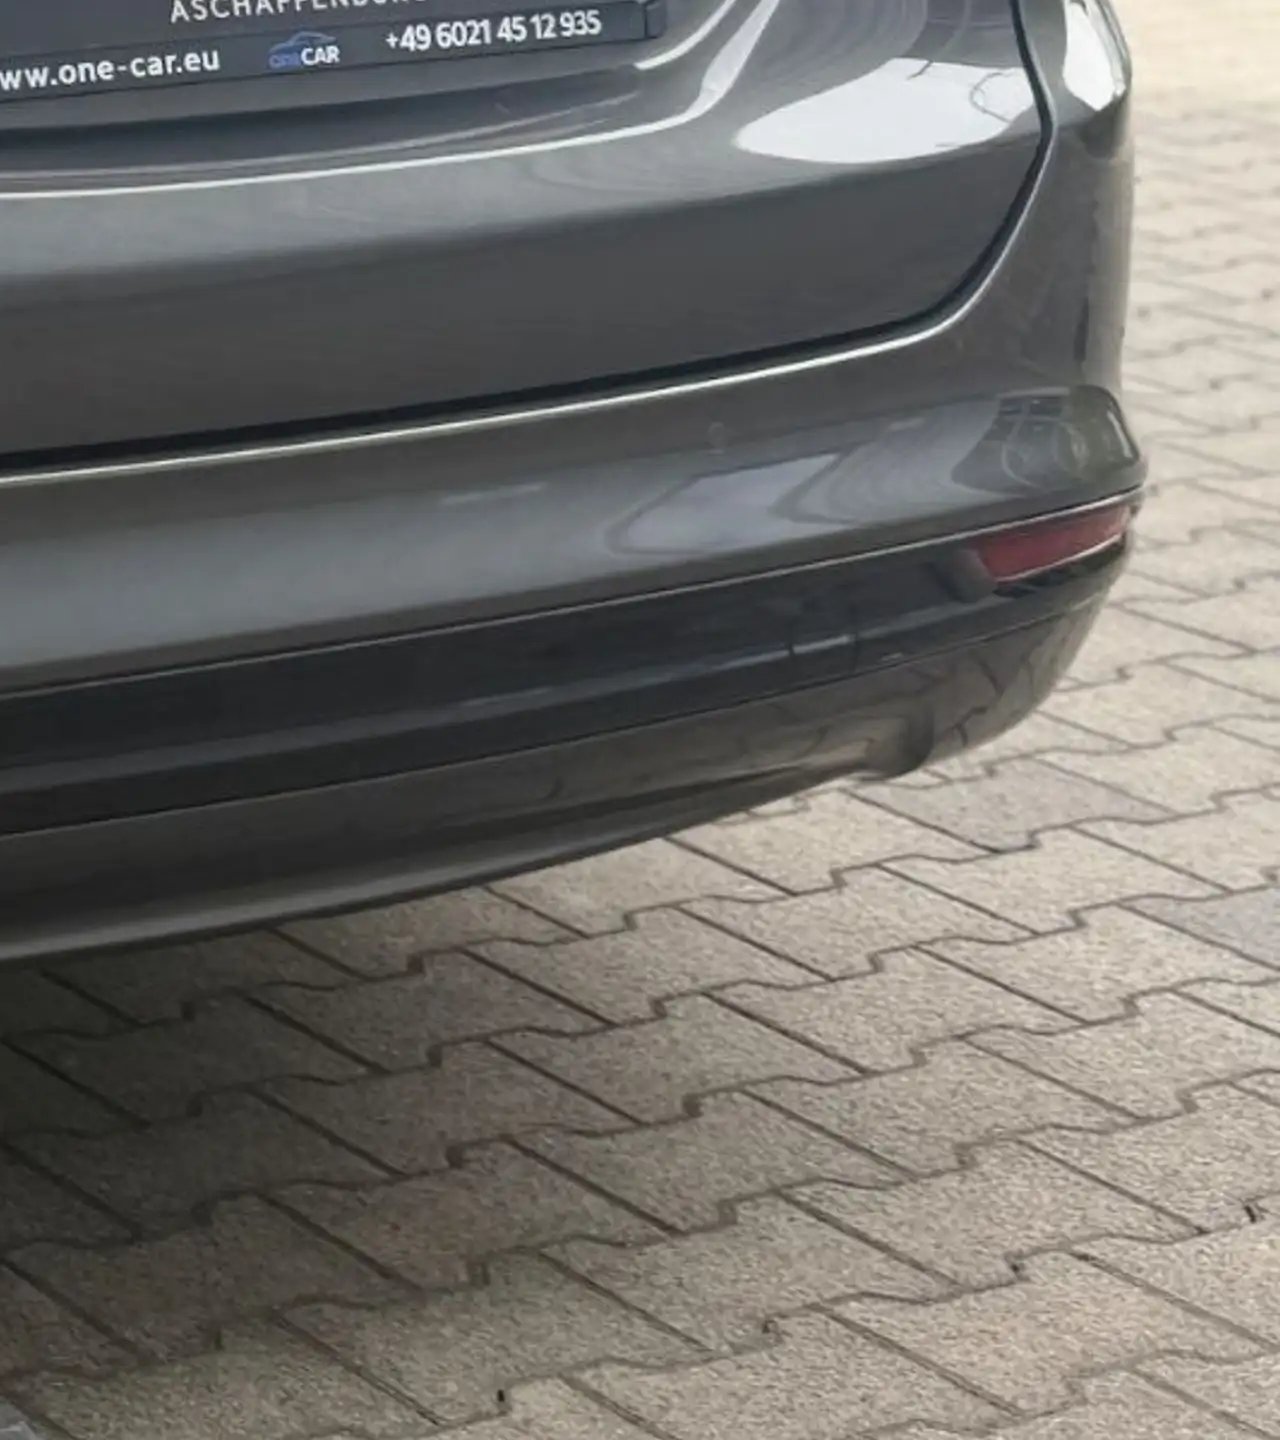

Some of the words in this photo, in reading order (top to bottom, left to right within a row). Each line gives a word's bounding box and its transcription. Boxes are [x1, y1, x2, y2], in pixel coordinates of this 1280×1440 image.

[386, 23, 432, 52] +49
[435, 19, 491, 48] 6021
[496, 16, 527, 43] 45
[530, 13, 557, 40] 12
[560, 9, 602, 38] 935
